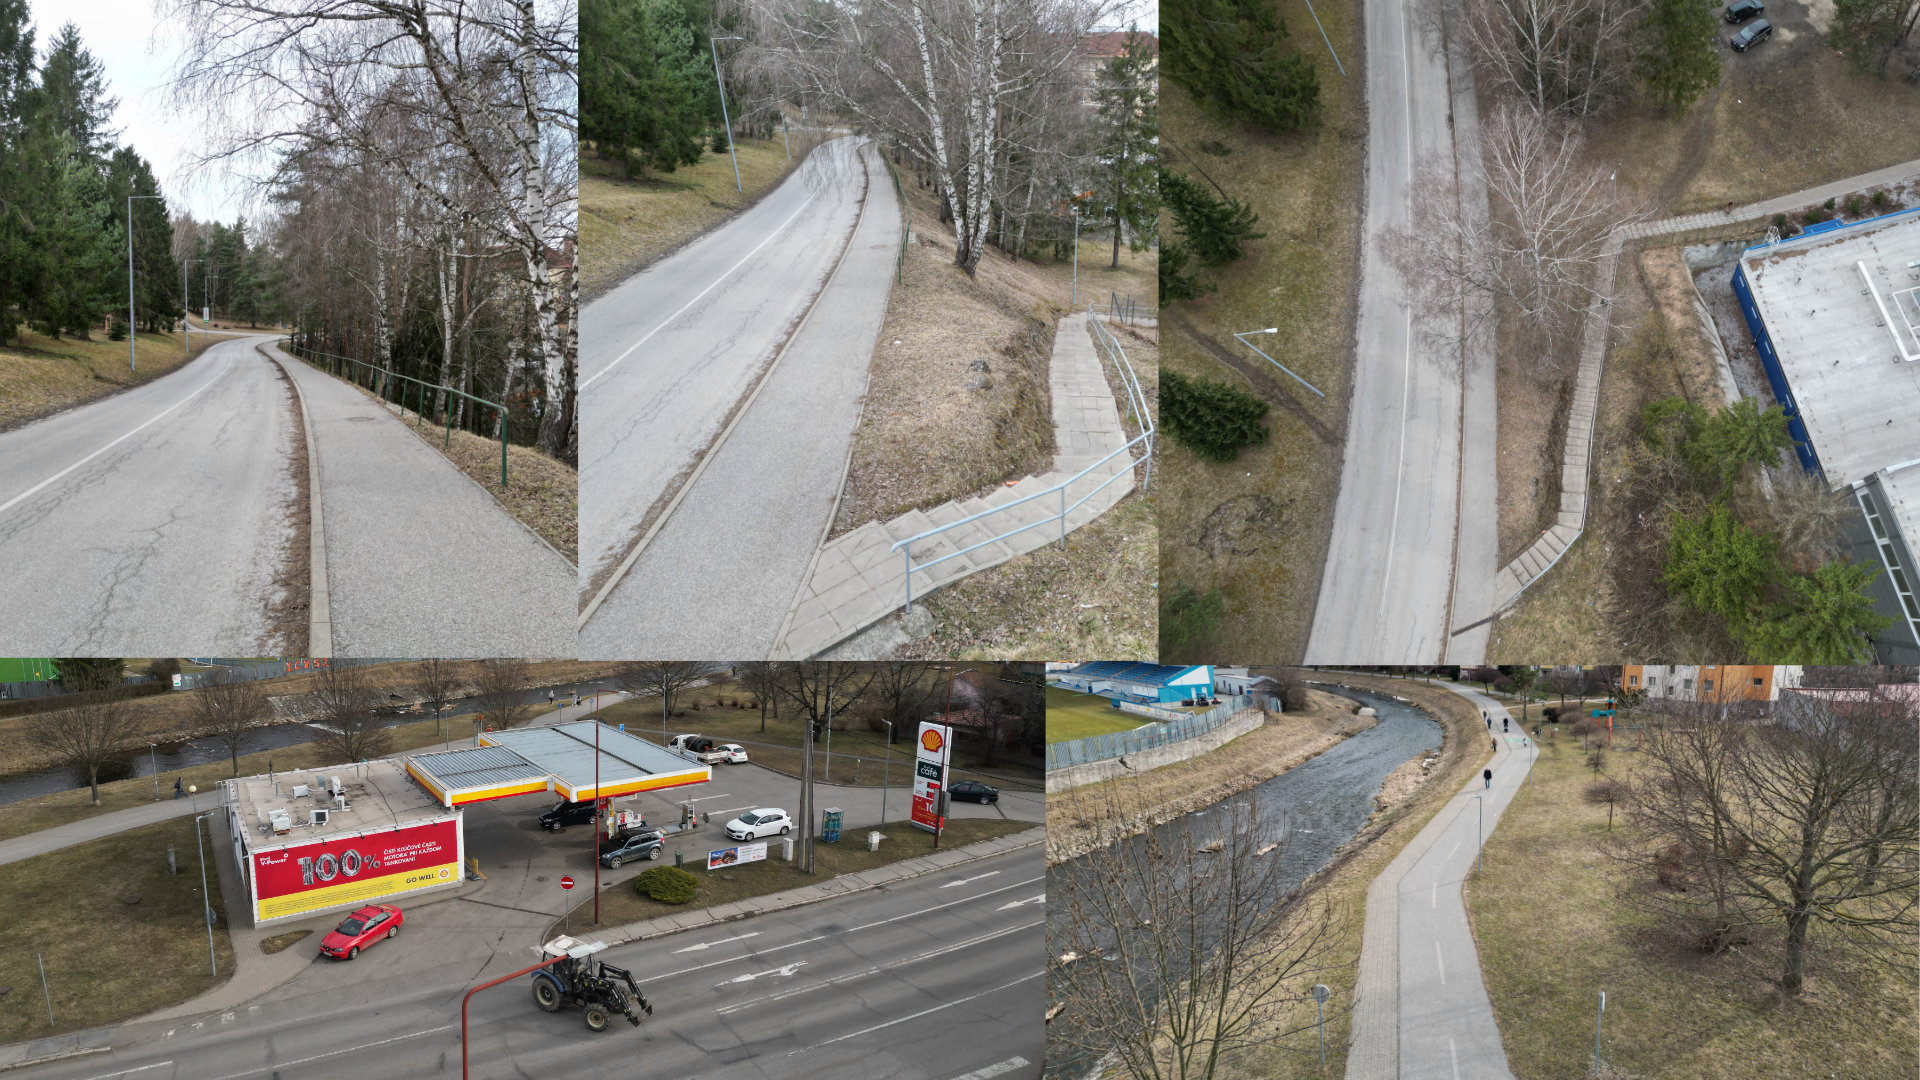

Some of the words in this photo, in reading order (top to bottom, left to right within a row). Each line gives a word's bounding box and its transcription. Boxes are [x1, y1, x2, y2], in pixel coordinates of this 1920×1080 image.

[260, 858, 287, 866] V-Power
[297, 849, 381, 886] 100%
[418, 873, 435, 881] WELL
